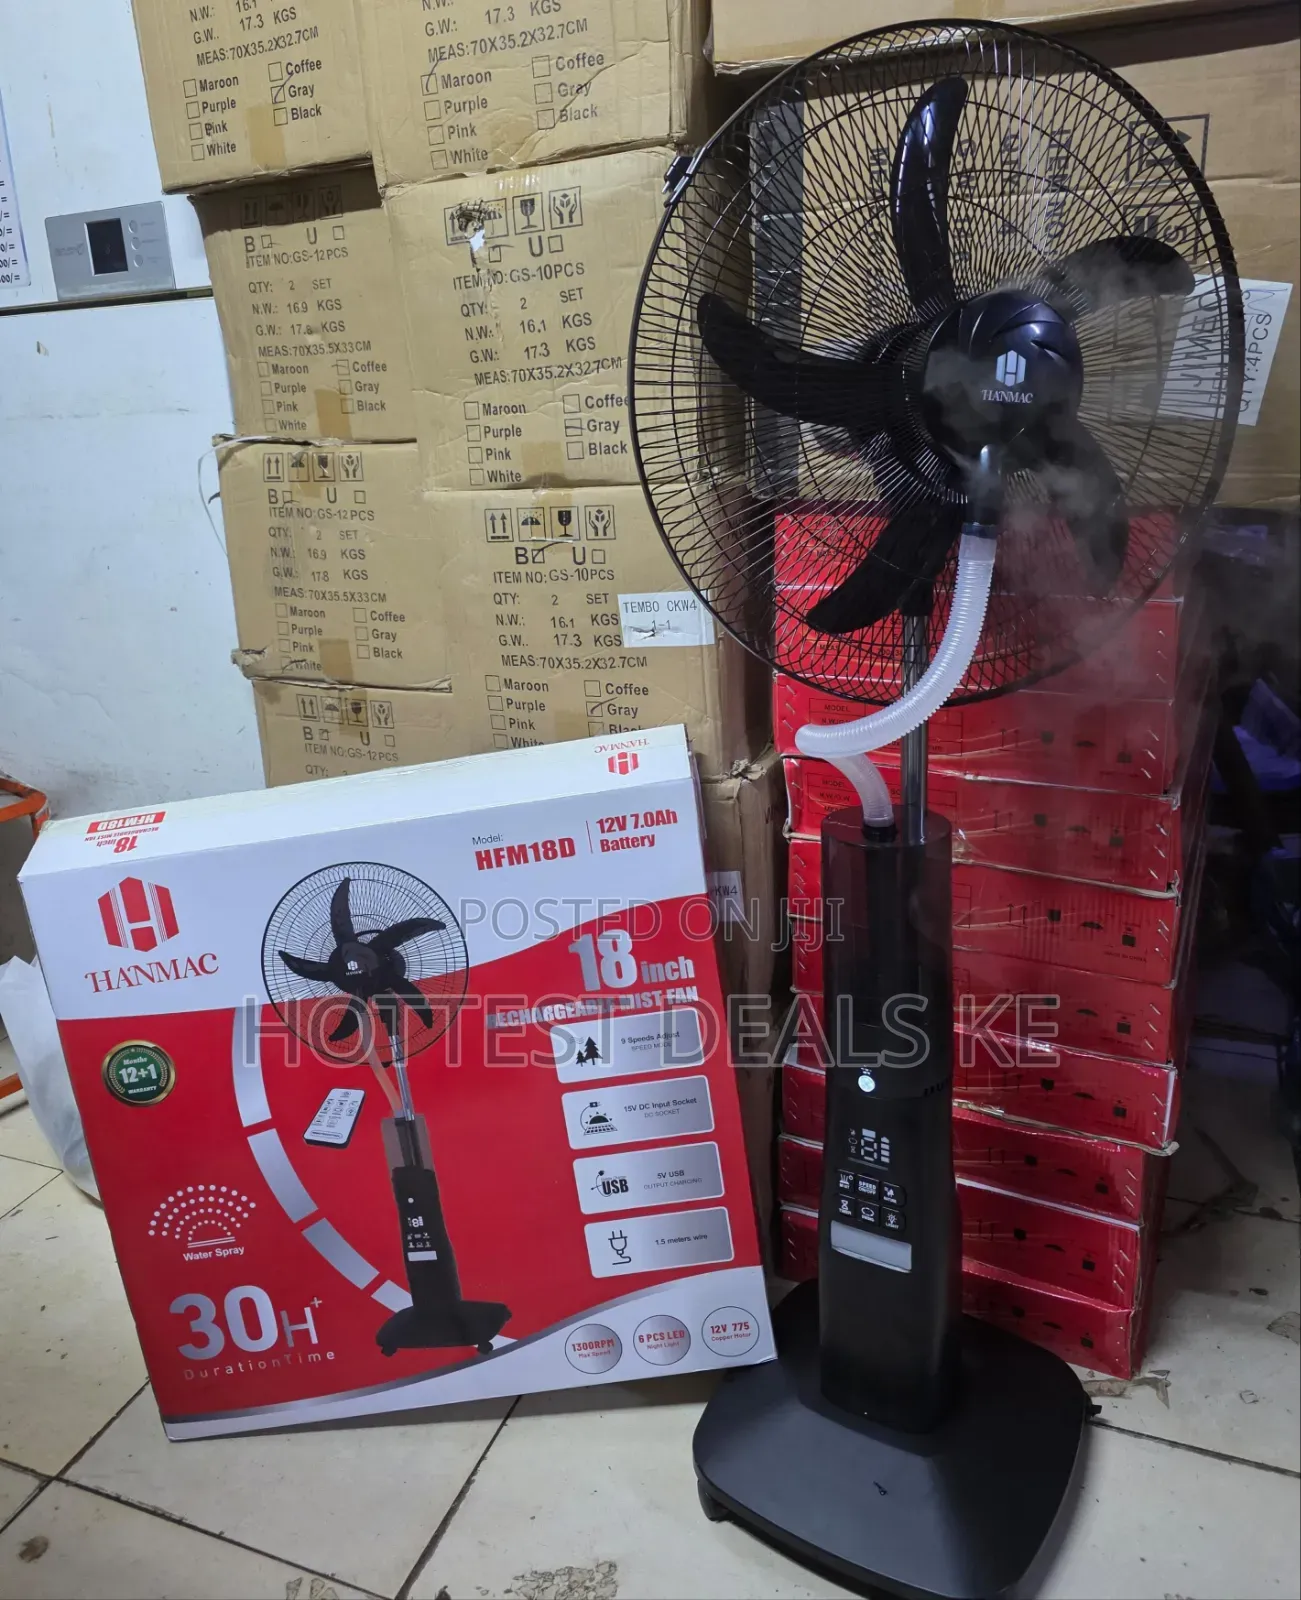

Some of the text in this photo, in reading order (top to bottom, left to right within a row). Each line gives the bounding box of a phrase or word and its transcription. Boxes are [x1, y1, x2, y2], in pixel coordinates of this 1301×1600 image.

[239, 6, 297, 31] 17.3 KGS
[485, 6, 515, 25] 17.3
[530, 0, 562, 16] KGS
[196, 26, 319, 67] MEAS:70X35.2X32.7CM
[428, 18, 588, 63] MEAS:70X35.2X32.7CM
[285, 58, 322, 76] Coffee
[555, 53, 605, 71] Coffee
[199, 75, 239, 93] Maroon
[441, 70, 492, 89] Maroon
[288, 83, 315, 99] Gray
[557, 80, 592, 98] Gray
[201, 98, 236, 115] Purple
[291, 105, 322, 120] Black
[444, 95, 488, 115] Purple
[559, 104, 599, 122] Black
[204, 121, 228, 136] Pink
[448, 124, 477, 140] Pink
[207, 141, 236, 156] White
[450, 148, 488, 165] White
[246, 252, 270, 269] ITEM
[248, 278, 332, 294] QTY: SET
[453, 274, 482, 290] ITEM
[560, 287, 584, 303] SET
[317, 299, 342, 311] KGS
[290, 323, 313, 336] 17.8
[321, 321, 345, 332] KGS
[520, 319, 546, 334] 16.1
[562, 312, 592, 329] KGS
[524, 343, 550, 360] 17.3
[566, 336, 596, 353] KGS
[272, 364, 309, 375] Maroon
[352, 361, 387, 372] Coffee
[274, 383, 306, 396] Purple
[355, 382, 379, 394] Gray
[982, 389, 1033, 403] HANMAC
[277, 401, 298, 412] Pink
[357, 400, 386, 411] Black
[482, 403, 526, 416] Maroon
[279, 420, 306, 431] White
[484, 425, 522, 440] Purple
[587, 419, 620, 434] Gray
[486, 448, 512, 461] Pink
[588, 441, 628, 456] Black
[487, 470, 522, 484] White
[269, 506, 294, 518] ITEM
[268, 526, 359, 540] QTY: SET
[341, 549, 366, 560] KGS
[343, 569, 368, 580] KGS
[493, 571, 522, 584] ITEM
[493, 593, 609, 606] QTY: SET
[624, 599, 698, 614] TEMBO CKW4
[290, 606, 326, 618] Maroon
[370, 610, 406, 622] Coffee
[550, 616, 575, 629] 16.1
[591, 613, 619, 626] KGS
[292, 624, 323, 637] Purple
[371, 629, 397, 642] Gray
[293, 642, 314, 652] Pink
[554, 634, 622, 647] 17.3 KGS
[373, 647, 402, 659] Black
[501, 654, 648, 670] MEAS:70X35.2X32.7CM
[503, 678, 549, 692] Maroon
[605, 682, 649, 696] Coffee
[506, 698, 546, 712] Purple
[607, 704, 638, 719] Gray
[509, 718, 535, 730] Pink
[305, 743, 327, 755] ITEM
[594, 738, 649, 753] HANMAC
[305, 764, 329, 777] QTY:
[97, 814, 156, 832] HFM18D
[596, 809, 678, 834] 12V 7.0Ah
[114, 835, 138, 853] 18
[472, 833, 504, 845] Model:
[600, 834, 656, 853] Battery
[474, 837, 576, 871] HFM18D
[568, 929, 694, 992] 18 inch
[84, 953, 219, 993] HANMAC
[487, 986, 699, 1029] RECHARGEABLE MIST FAN
[628, 1035, 655, 1045] Speeds
[656, 1031, 680, 1041] Adjust
[119, 1063, 158, 1084] 12+1
[652, 1101, 671, 1110] Input
[672, 1098, 697, 1106] Socket
[654, 1109, 680, 1117] SOCKET
[669, 1169, 685, 1178] USB
[602, 1179, 629, 1195] USB
[655, 1233, 708, 1246] 1.5 meters wire
[183, 1246, 245, 1262] Water Spray
[710, 1321, 750, 1334] 12V 775
[638, 1330, 685, 1344] 6 PCS LED
[571, 1338, 615, 1352] 1300RPM
